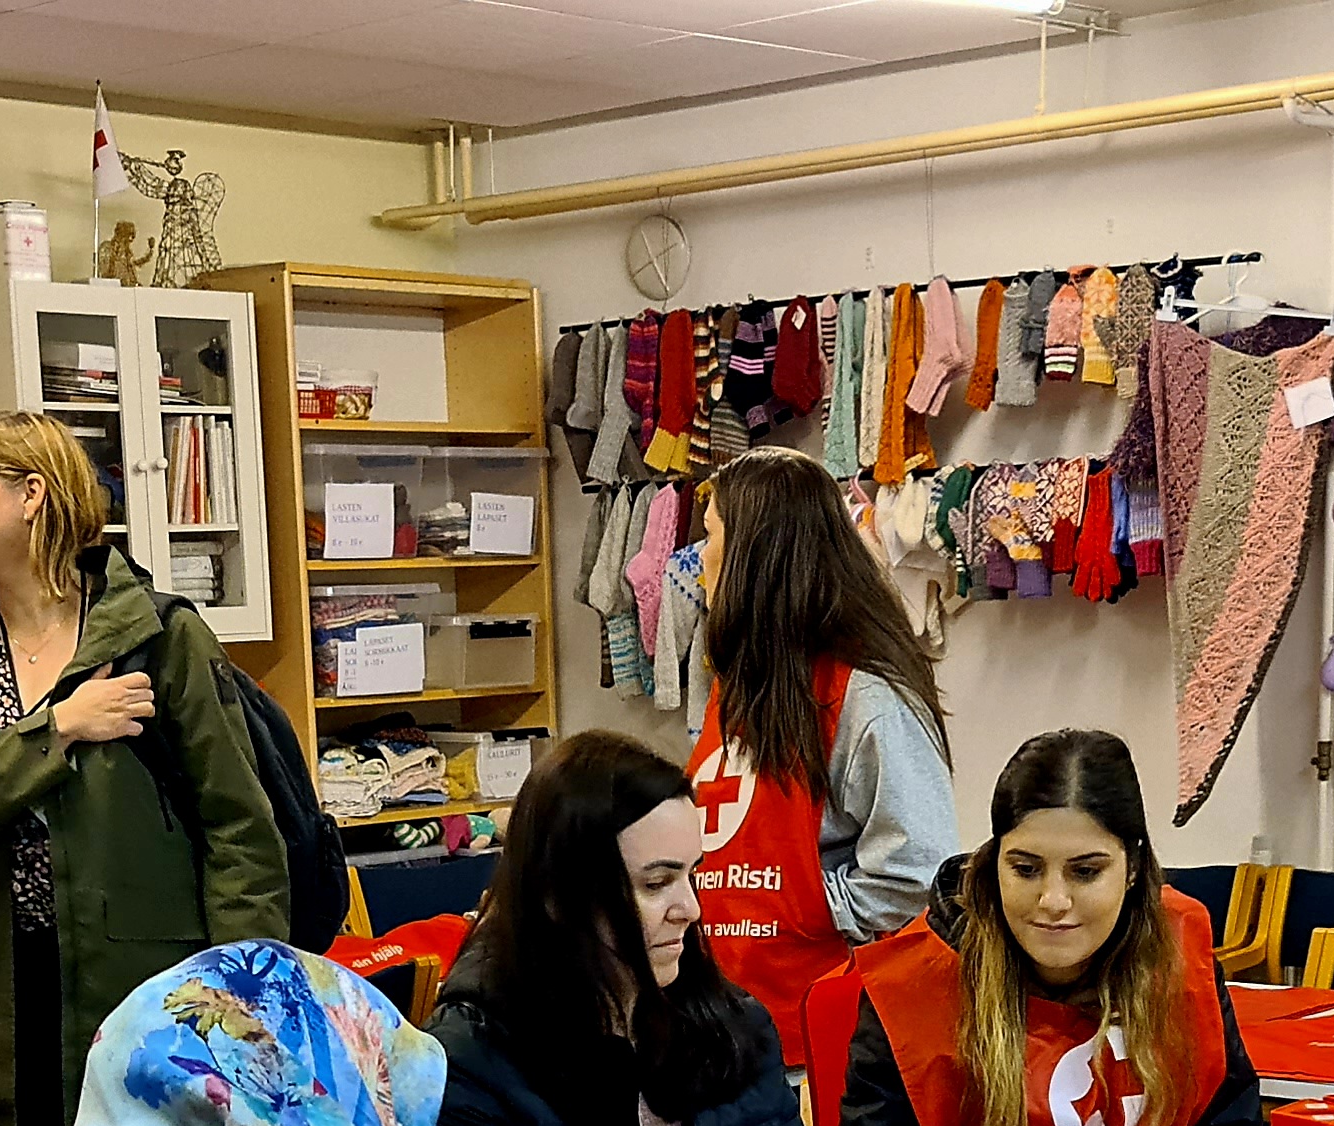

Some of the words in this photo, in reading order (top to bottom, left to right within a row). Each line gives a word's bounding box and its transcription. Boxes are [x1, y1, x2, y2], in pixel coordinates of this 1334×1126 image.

[694, 867, 724, 890] nen
[727, 863, 781, 890] Risti
[714, 919, 778, 937] avullasi
[371, 944, 403, 962] hjälp
